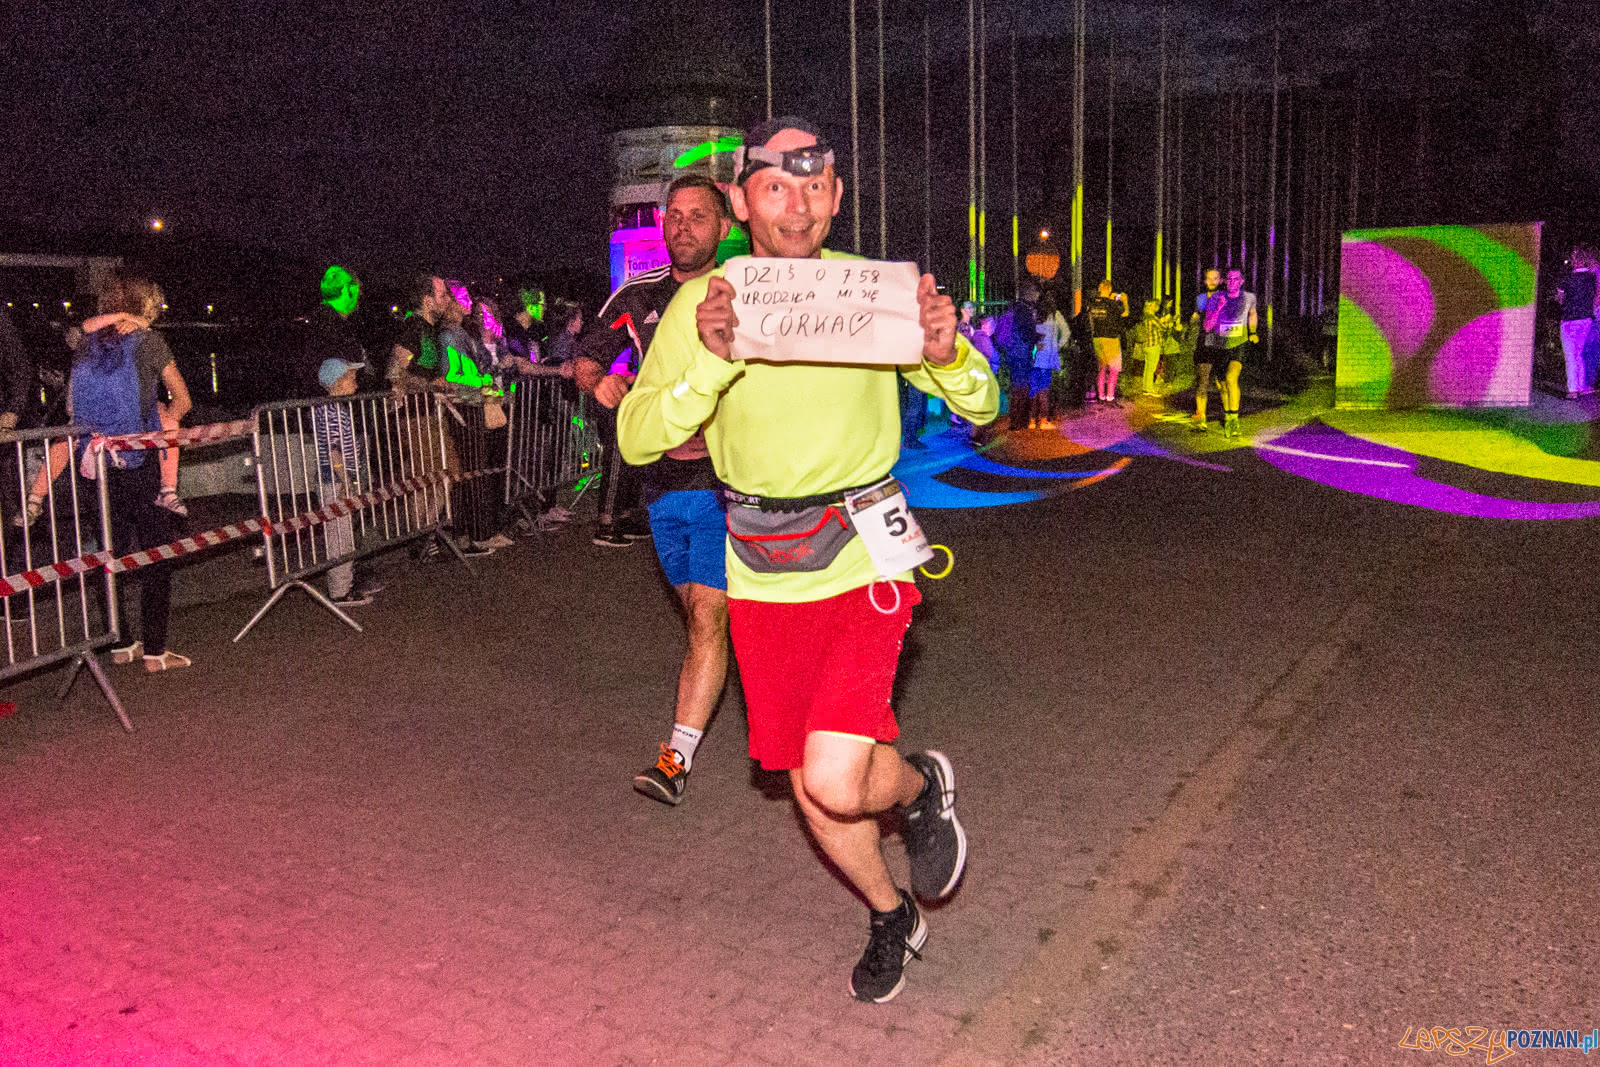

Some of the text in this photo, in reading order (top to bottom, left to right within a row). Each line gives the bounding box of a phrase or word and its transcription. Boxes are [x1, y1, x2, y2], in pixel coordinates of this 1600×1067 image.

[627, 260, 648, 271] Tom
[744, 263, 796, 287] DZIŚ
[836, 289, 853, 300] MI
[760, 308, 844, 337] CÓRKA
